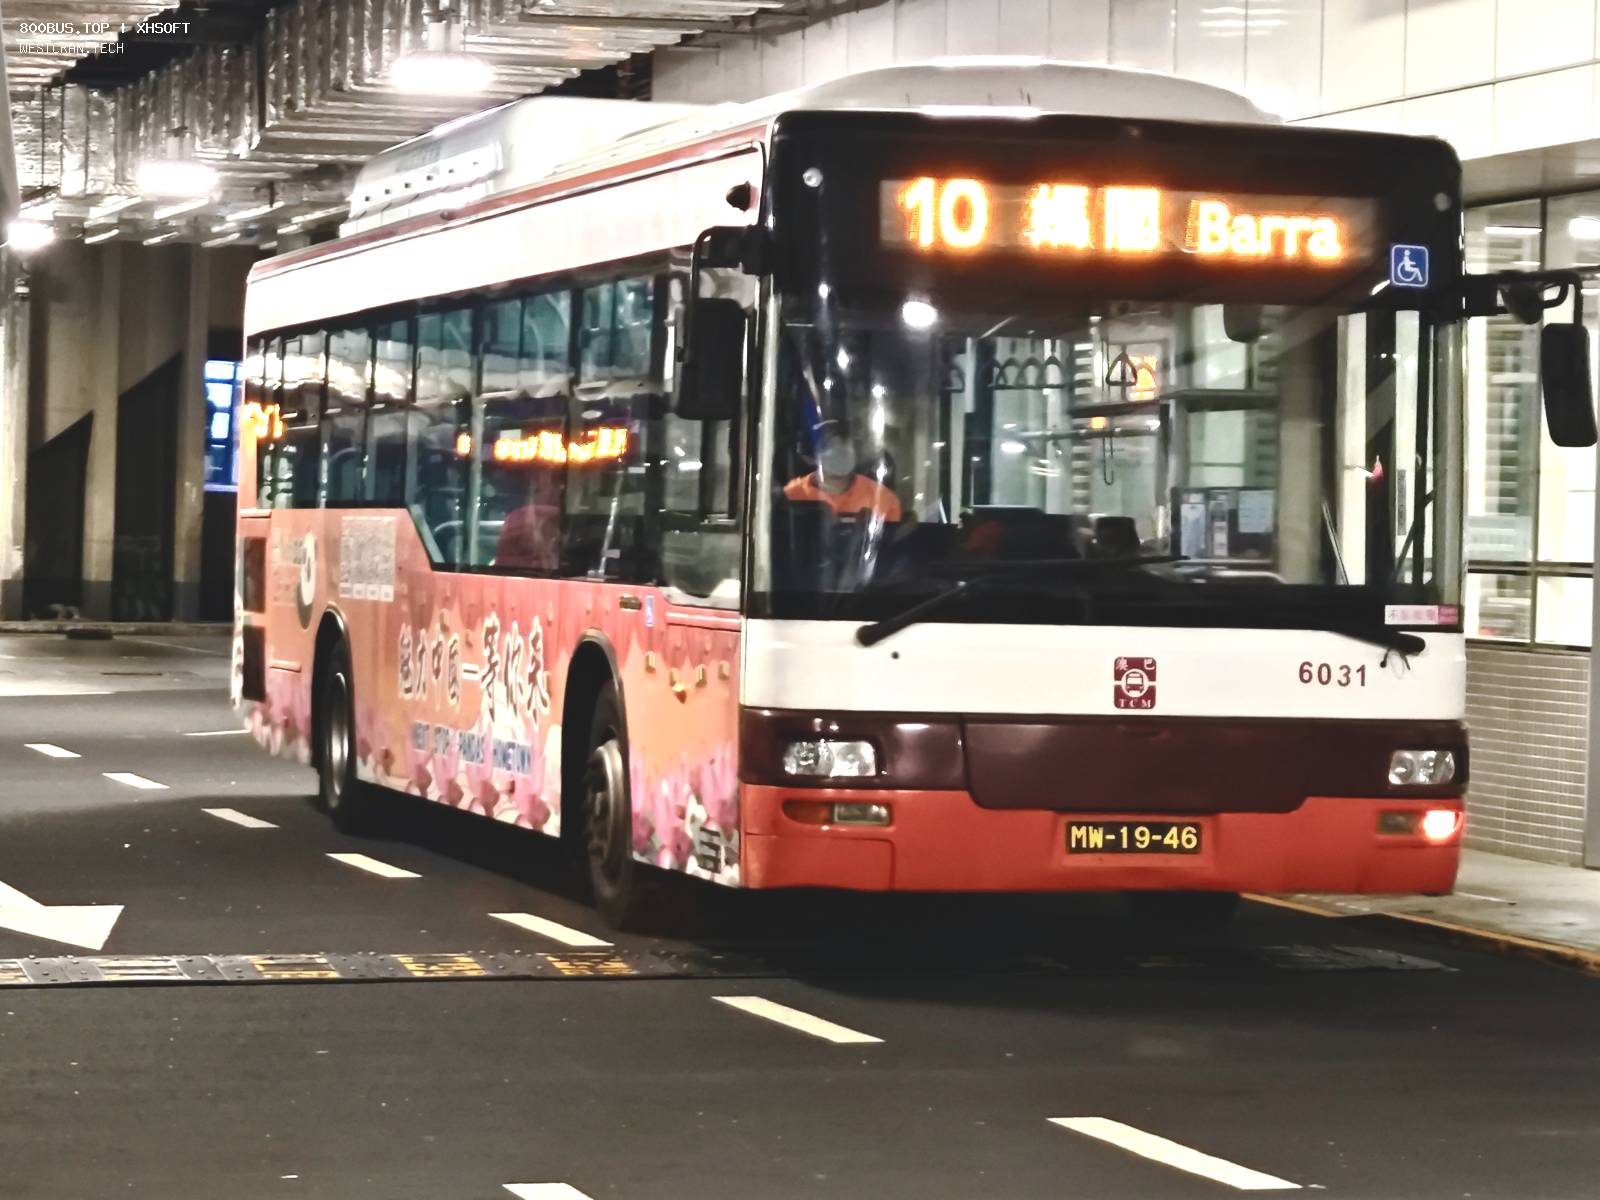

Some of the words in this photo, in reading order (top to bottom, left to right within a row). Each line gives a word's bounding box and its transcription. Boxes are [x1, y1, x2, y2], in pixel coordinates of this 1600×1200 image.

[904, 176, 988, 249] 10
[1198, 199, 1343, 259] Barra
[1299, 661, 1367, 688] 6031
[1071, 825, 1198, 849] MW-19-46
